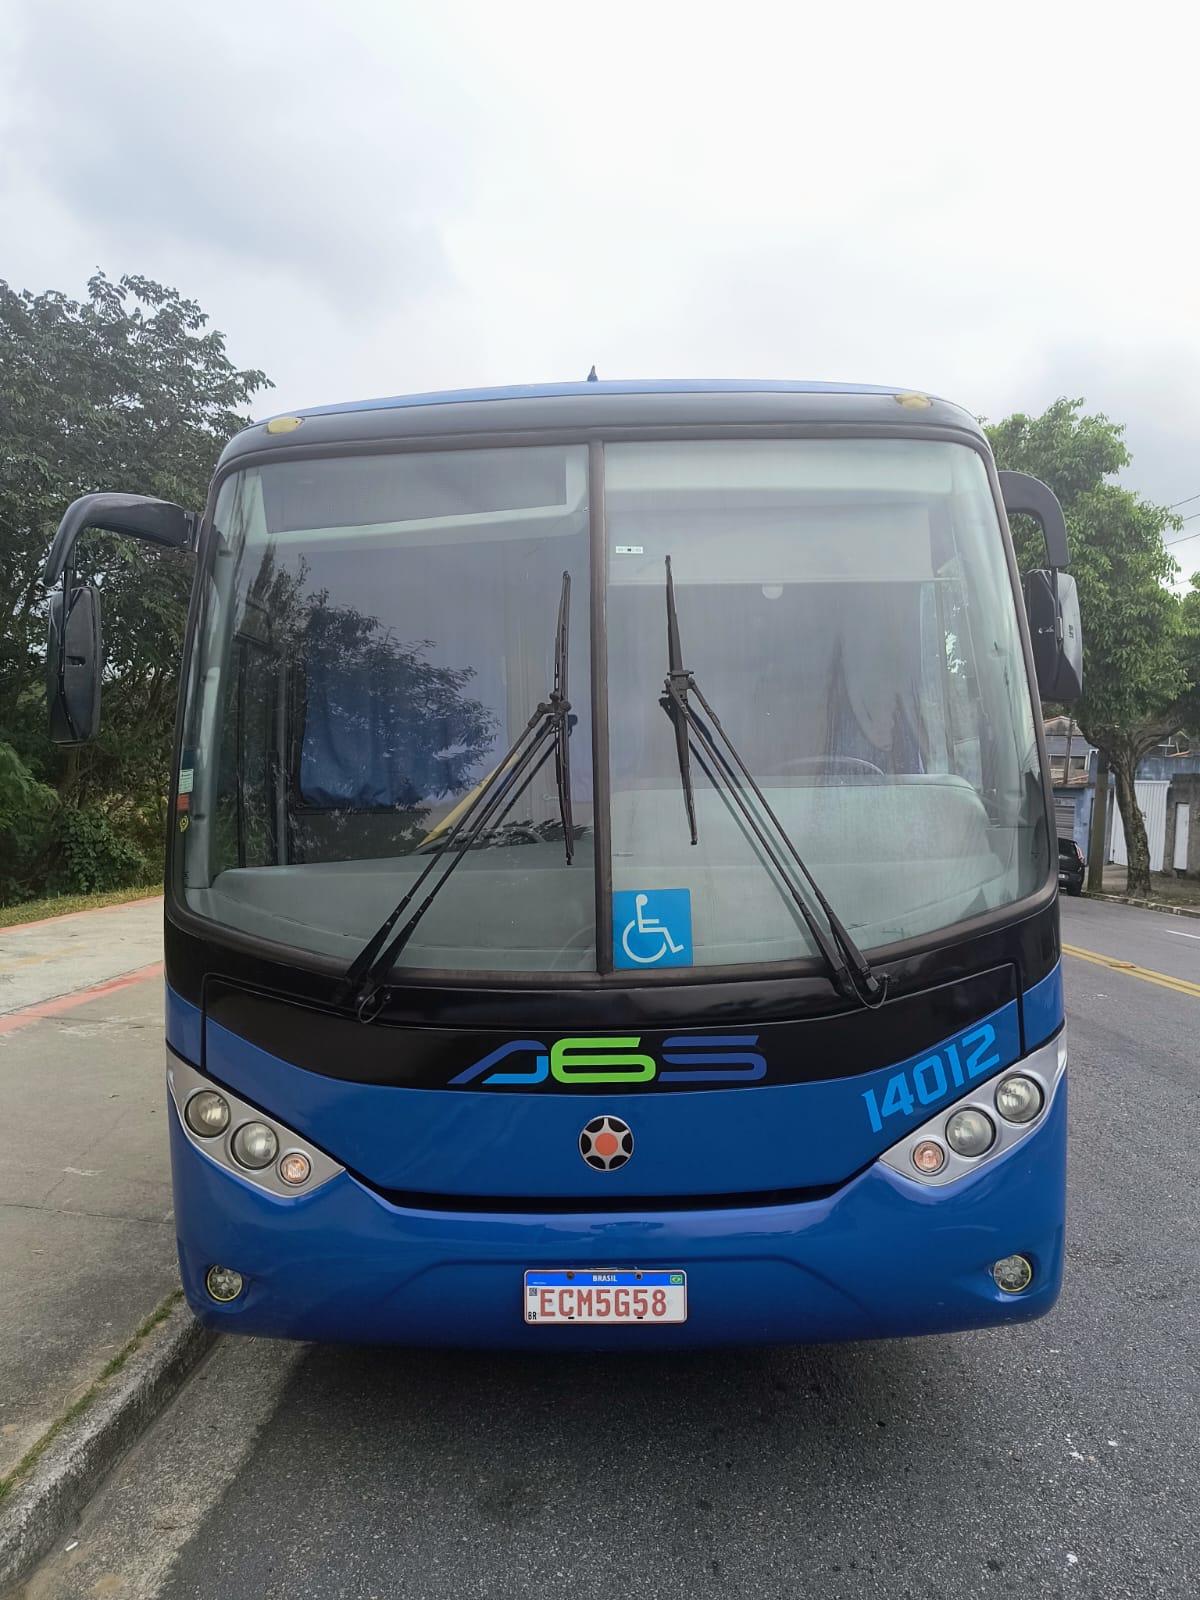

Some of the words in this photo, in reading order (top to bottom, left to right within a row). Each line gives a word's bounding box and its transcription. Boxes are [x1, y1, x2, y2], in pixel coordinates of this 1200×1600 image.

[861, 1024, 1000, 1133] 14012
[592, 1274, 618, 1283] BRASIL
[540, 1288, 667, 1317] ECM5G58
[528, 1311, 537, 1320] BR
